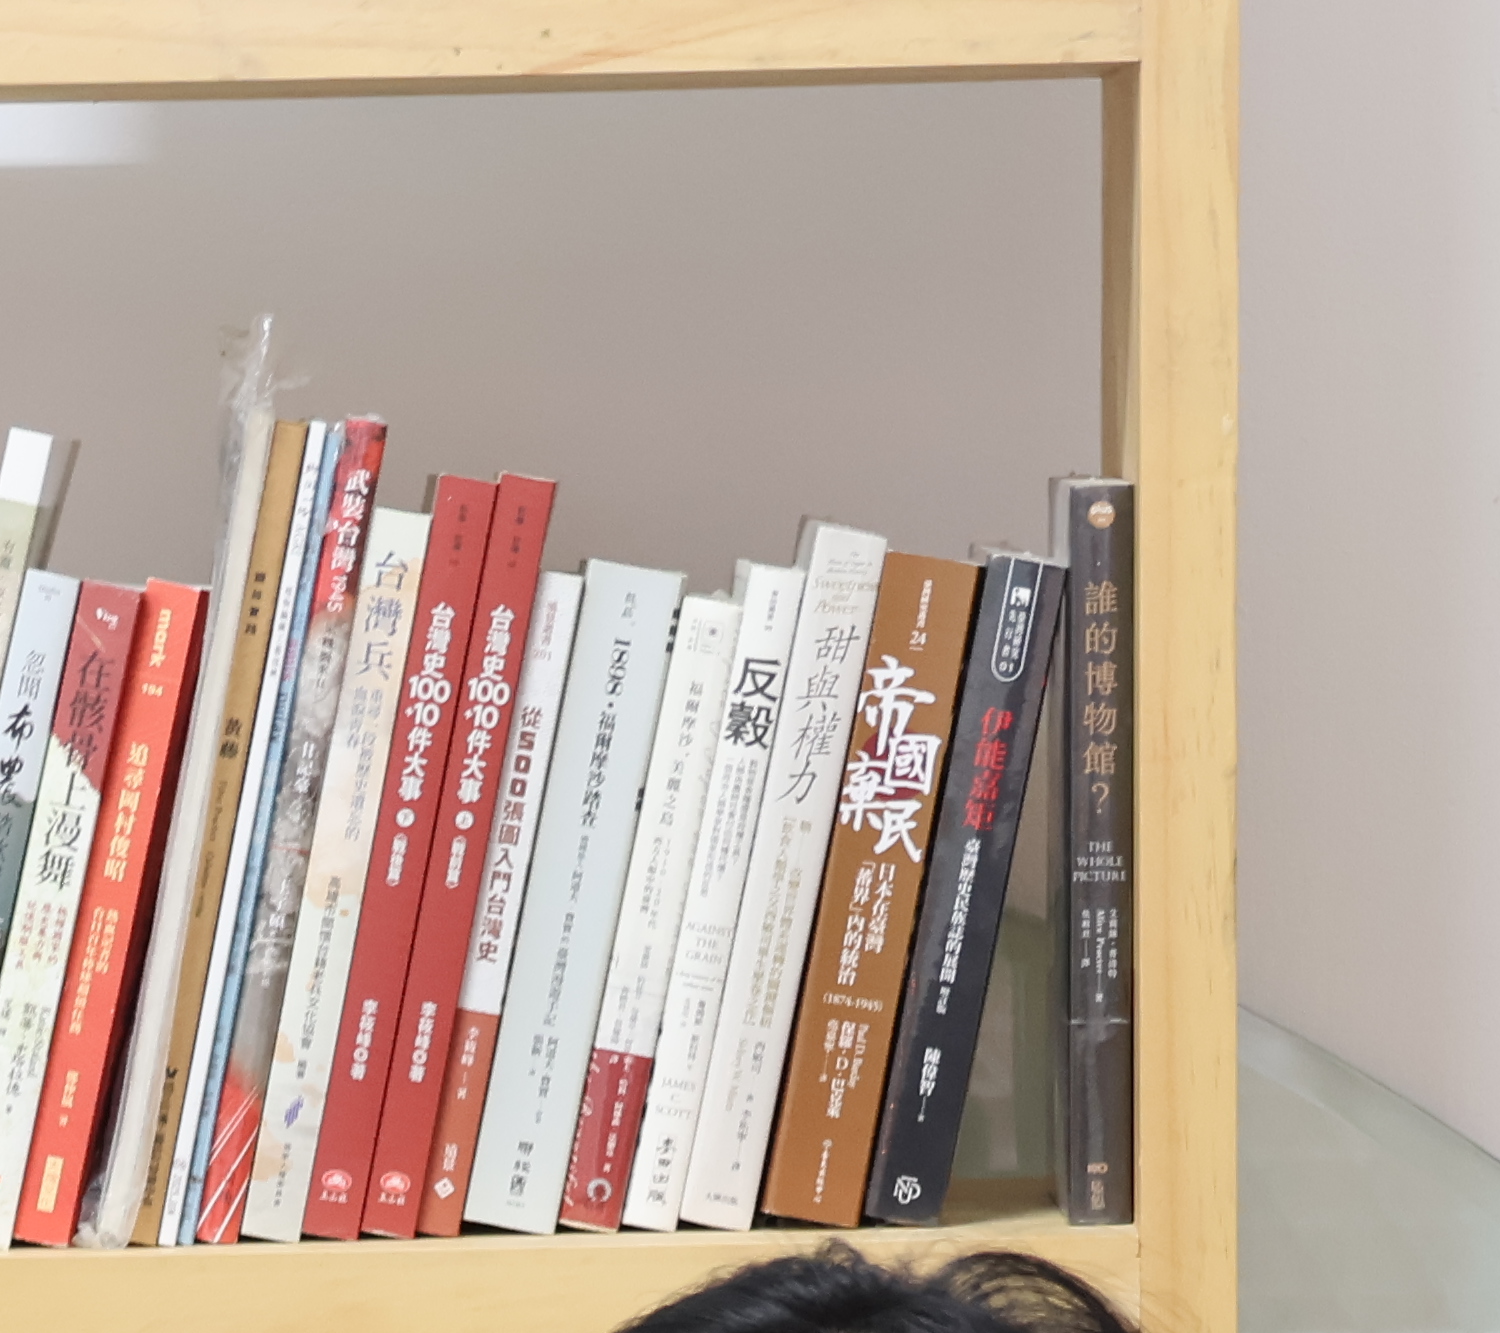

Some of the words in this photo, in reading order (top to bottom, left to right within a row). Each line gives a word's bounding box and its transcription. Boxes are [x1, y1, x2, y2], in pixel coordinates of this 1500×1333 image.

[149, 607, 172, 668] mark
[355, 550, 409, 682] 台灣兵
[724, 657, 782, 751] 反穀
[776, 623, 861, 805] 甜與權力
[1082, 580, 1119, 815] 誰的博物館?
[962, 705, 1015, 832] 伊能嘉矩
